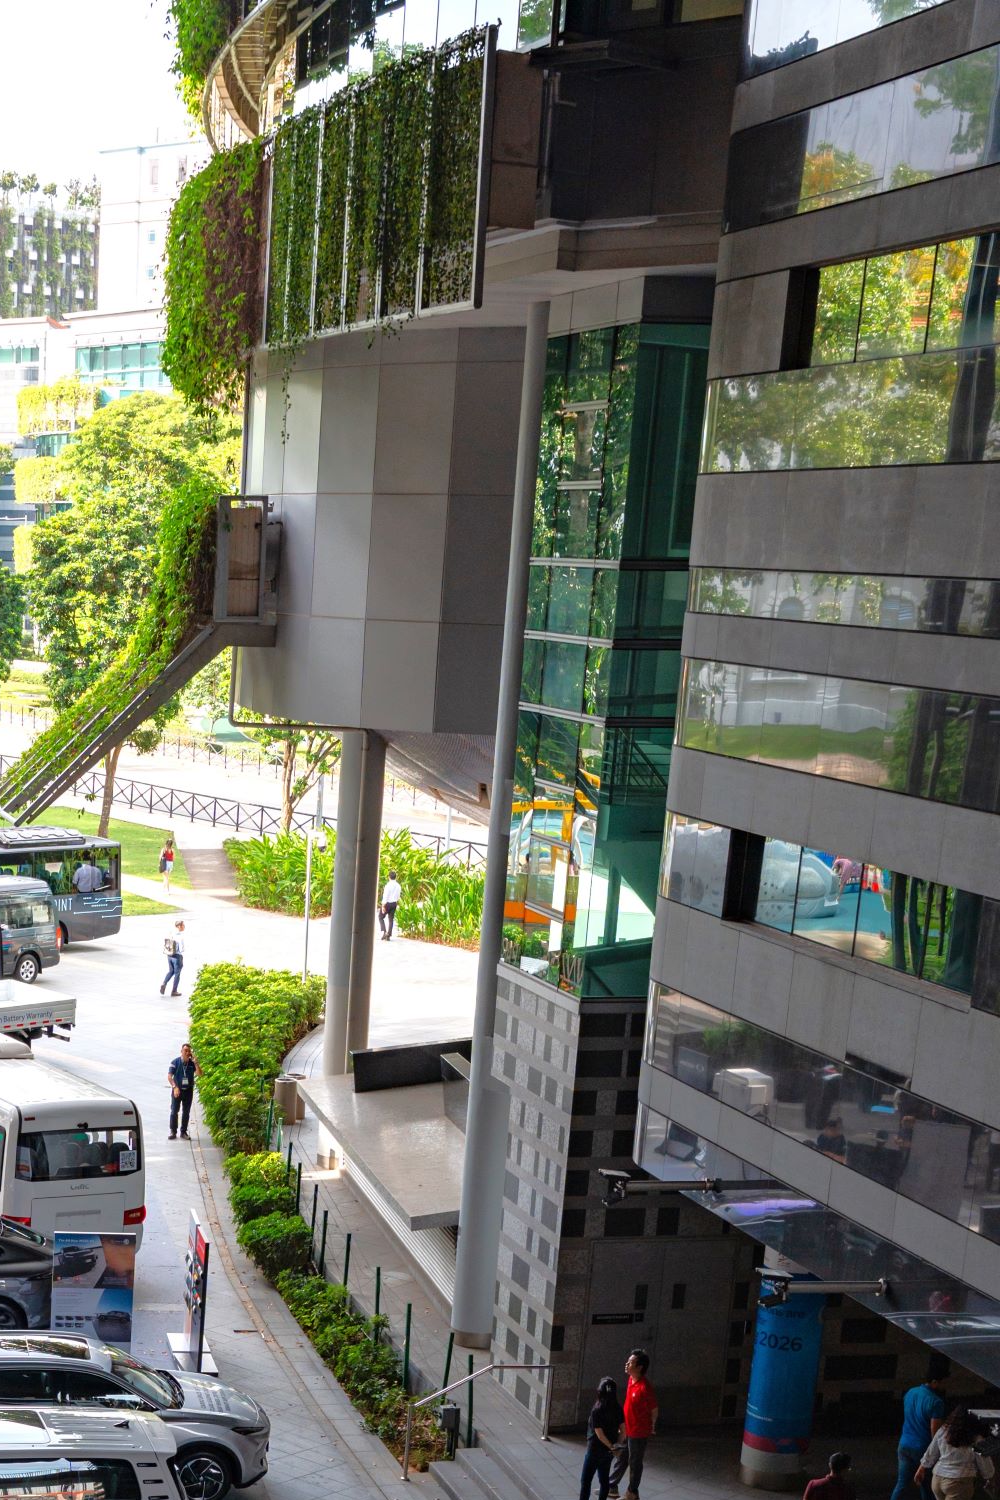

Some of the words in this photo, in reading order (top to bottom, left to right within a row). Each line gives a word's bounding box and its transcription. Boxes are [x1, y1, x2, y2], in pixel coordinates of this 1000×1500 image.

[3, 1013, 25, 1023] Battery
[26, 1011, 53, 1020] Warranty
[758, 1330, 803, 1352] 2026
